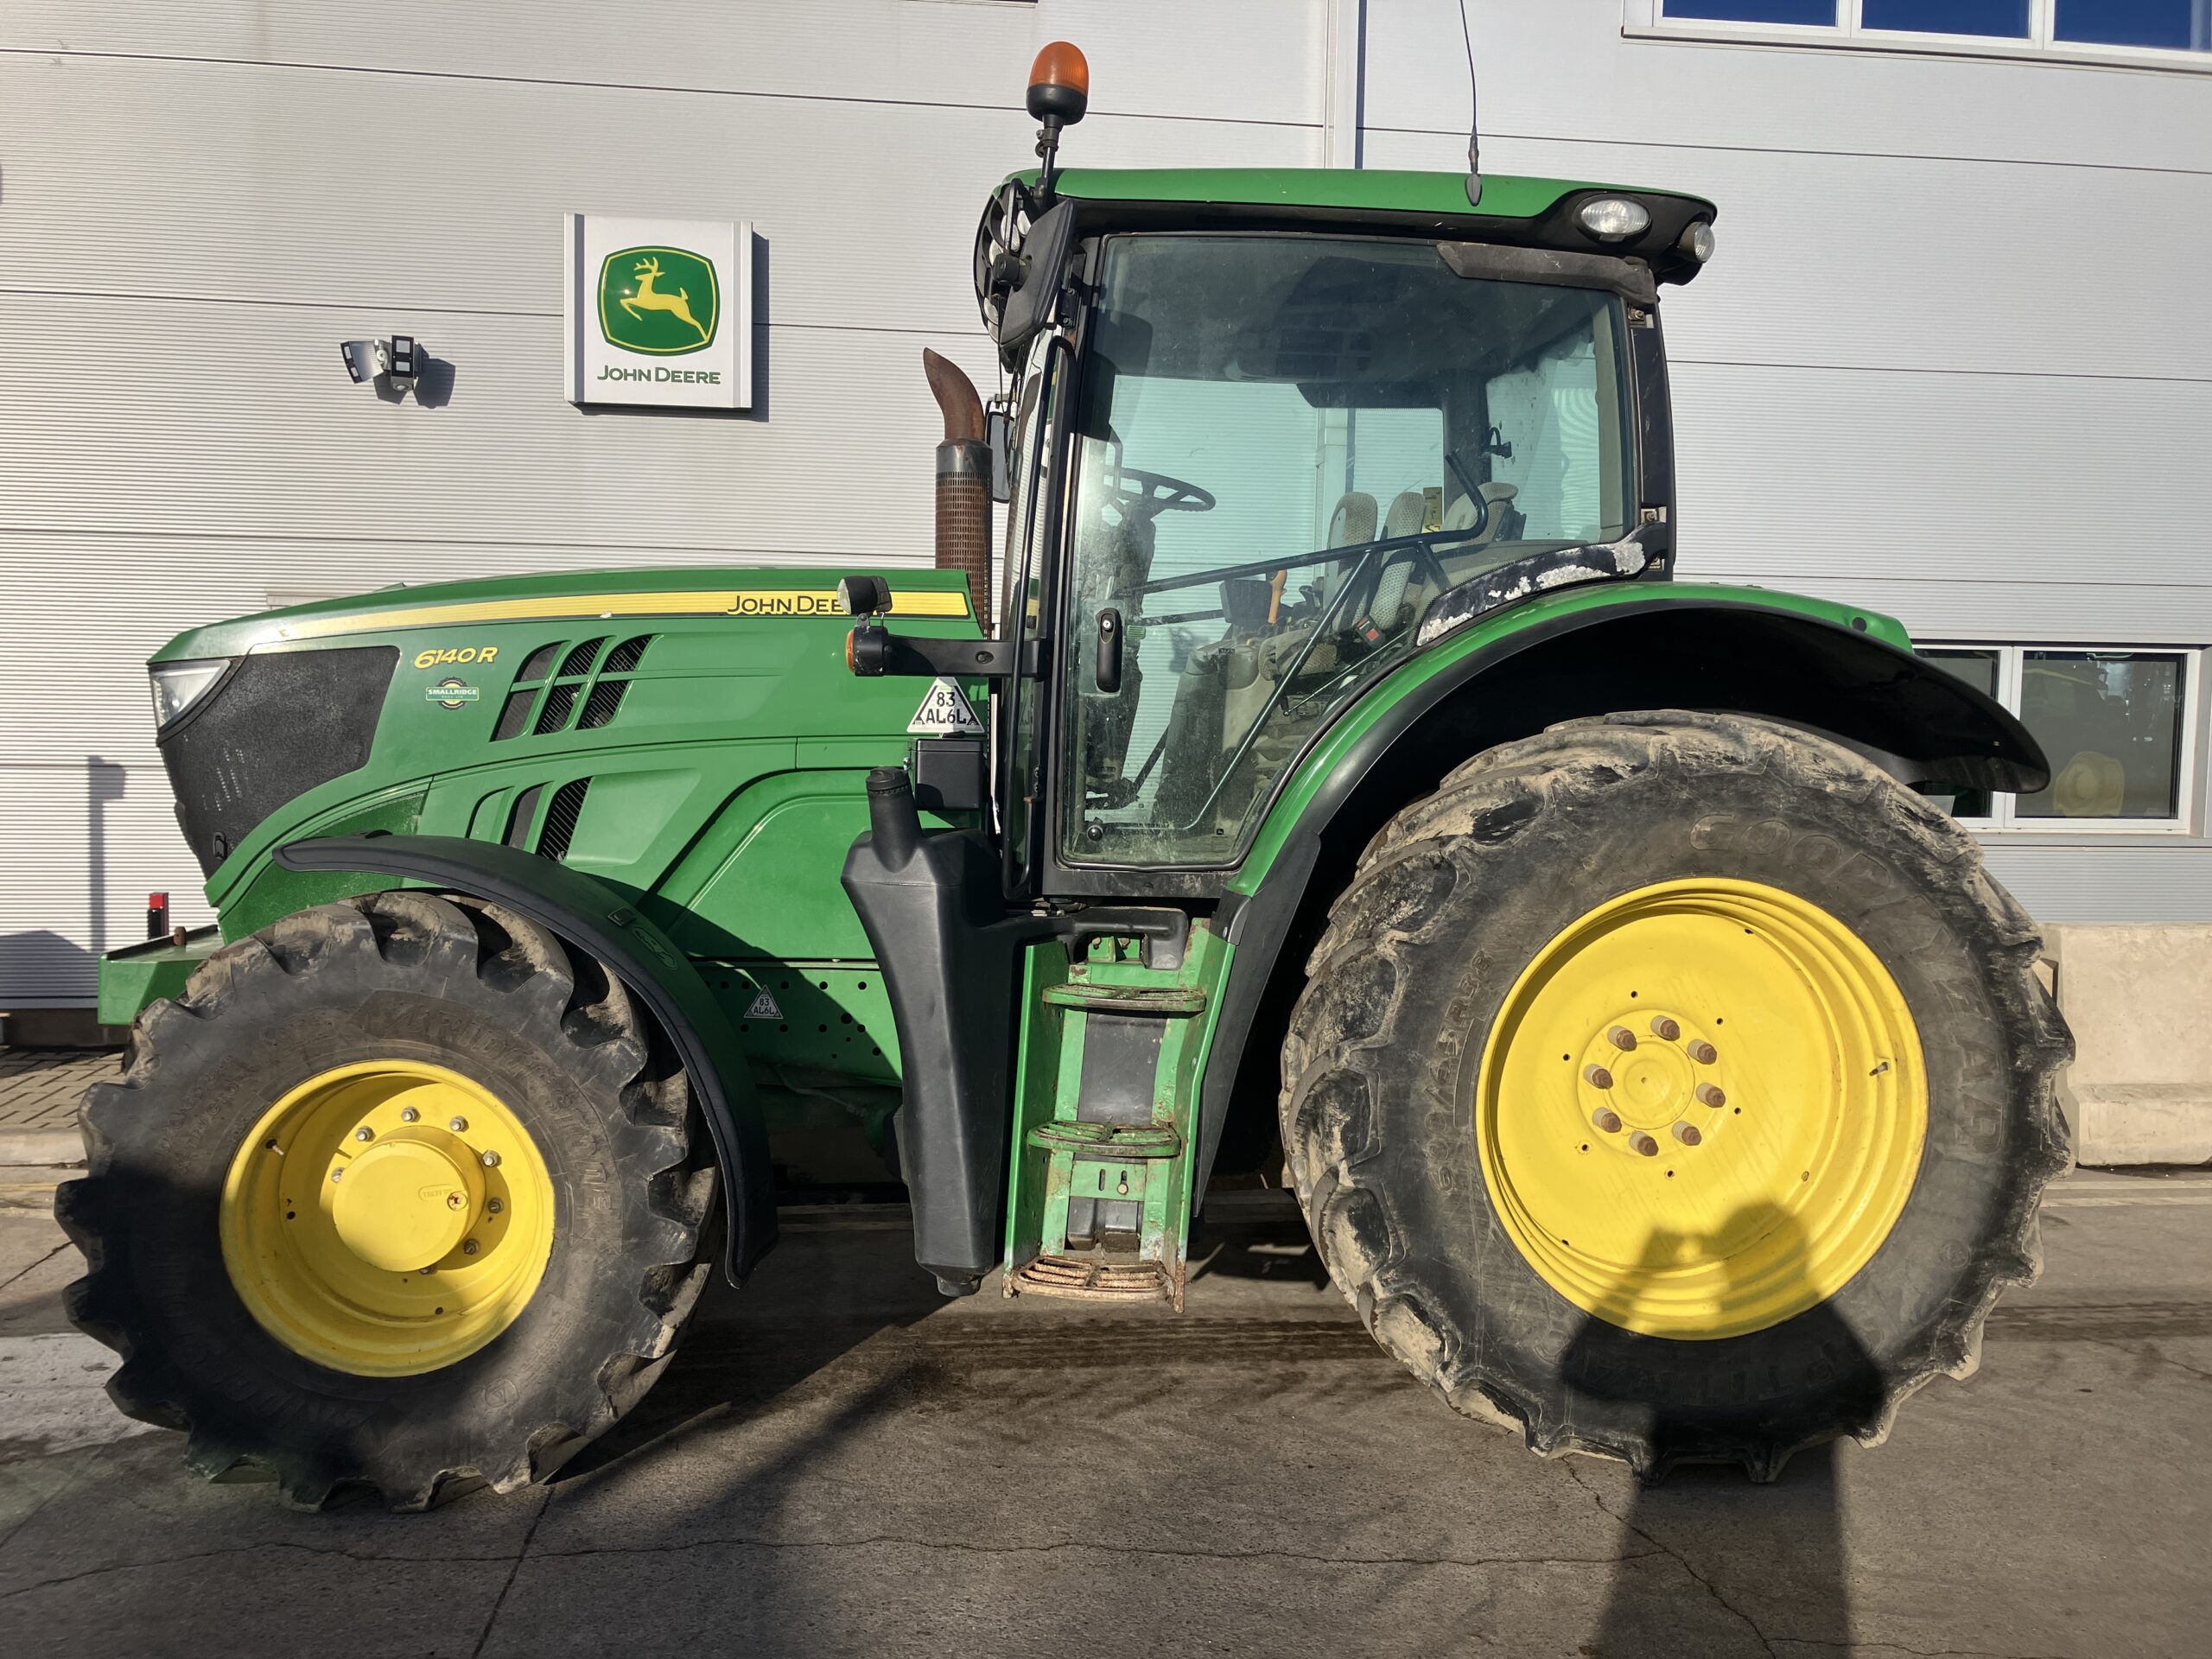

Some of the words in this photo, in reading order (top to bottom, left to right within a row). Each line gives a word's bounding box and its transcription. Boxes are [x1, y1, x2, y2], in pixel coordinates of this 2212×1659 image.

[597, 365, 652, 382] JOHN
[655, 366, 721, 385] DEERE
[728, 595, 791, 613] JOHN
[797, 595, 844, 613] DEE
[937, 692, 956, 707] 83
[925, 709, 967, 724] AL6L
[753, 1006, 774, 1015] AL6L
